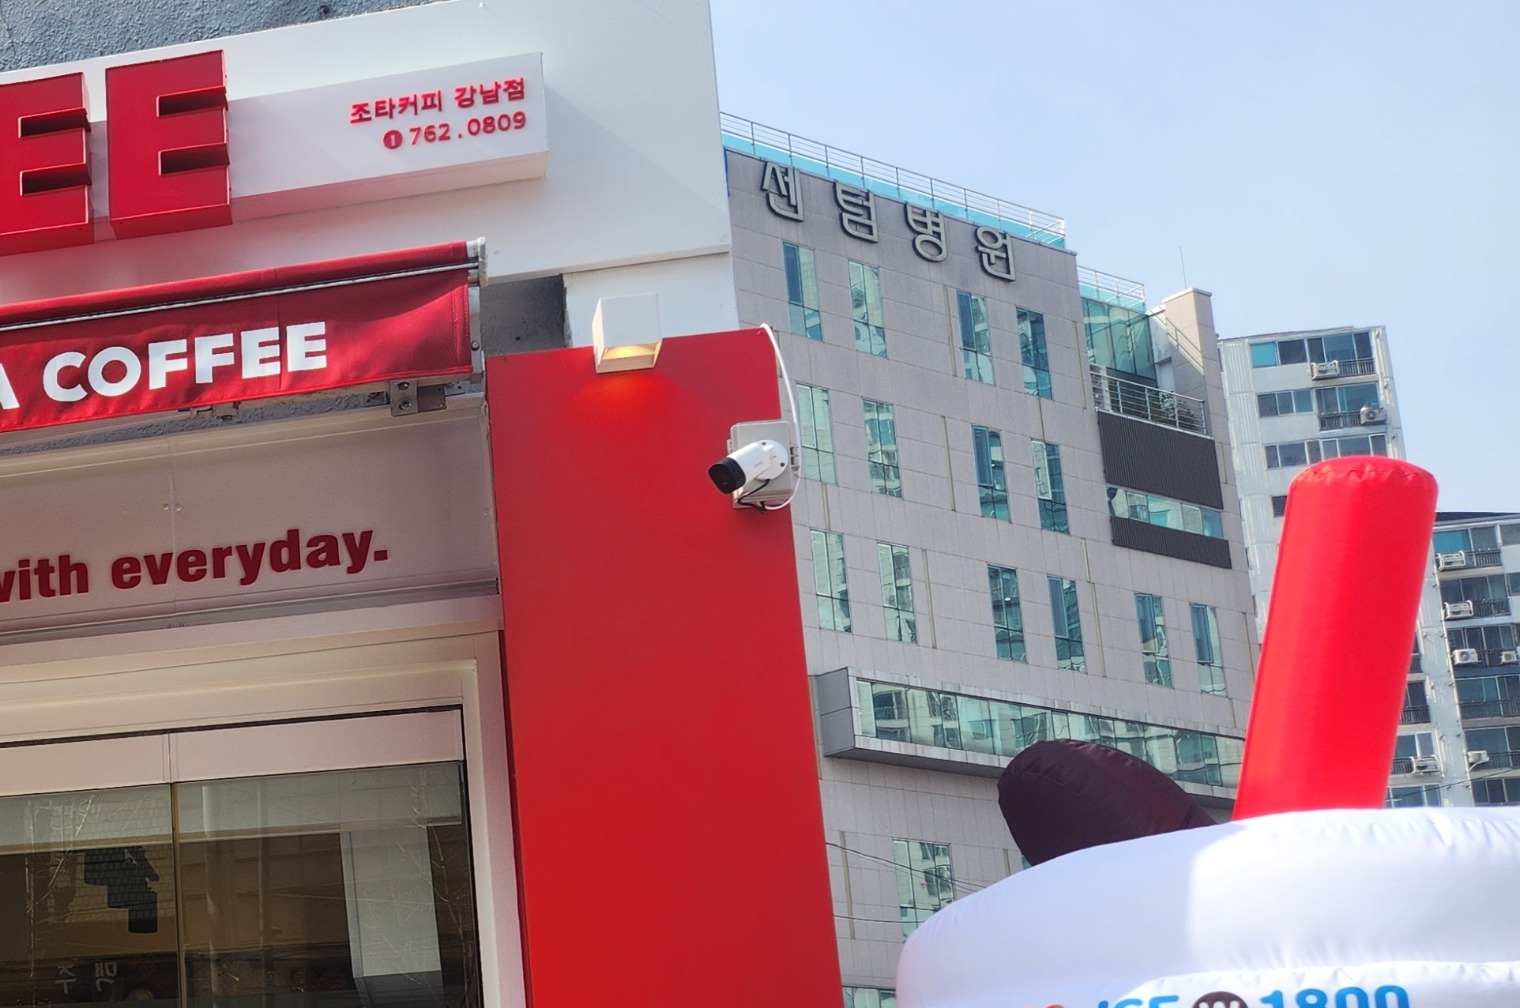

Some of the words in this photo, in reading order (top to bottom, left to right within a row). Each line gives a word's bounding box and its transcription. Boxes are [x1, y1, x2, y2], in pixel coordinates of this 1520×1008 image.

[350, 90, 443, 124] 조타커피
[454, 77, 526, 109] 강남점
[409, 111, 527, 146] 762.0809
[42, 321, 328, 402] COFFEE
[110, 529, 389, 590] everyday.
